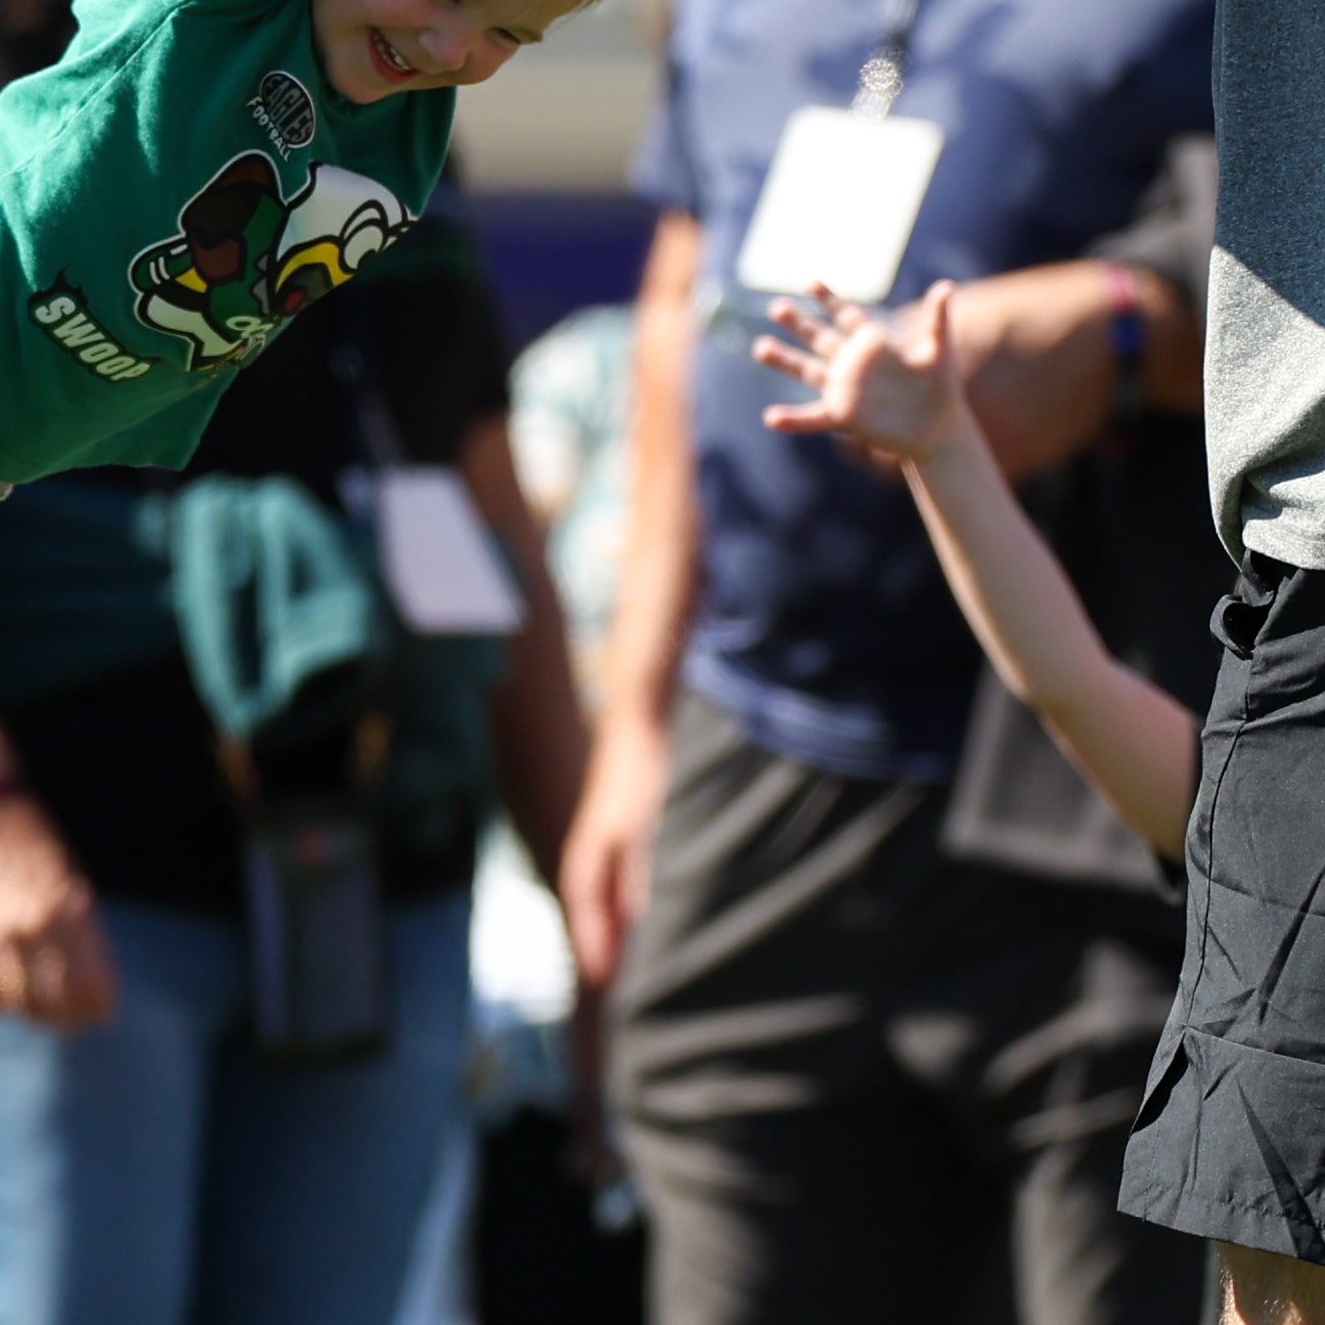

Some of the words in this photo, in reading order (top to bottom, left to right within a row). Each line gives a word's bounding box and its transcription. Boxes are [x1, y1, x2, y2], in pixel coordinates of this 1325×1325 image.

[246, 96, 291, 163] FOOTBALL
[262, 75, 314, 143] EAGLES
[35, 296, 151, 380] SWOOP
